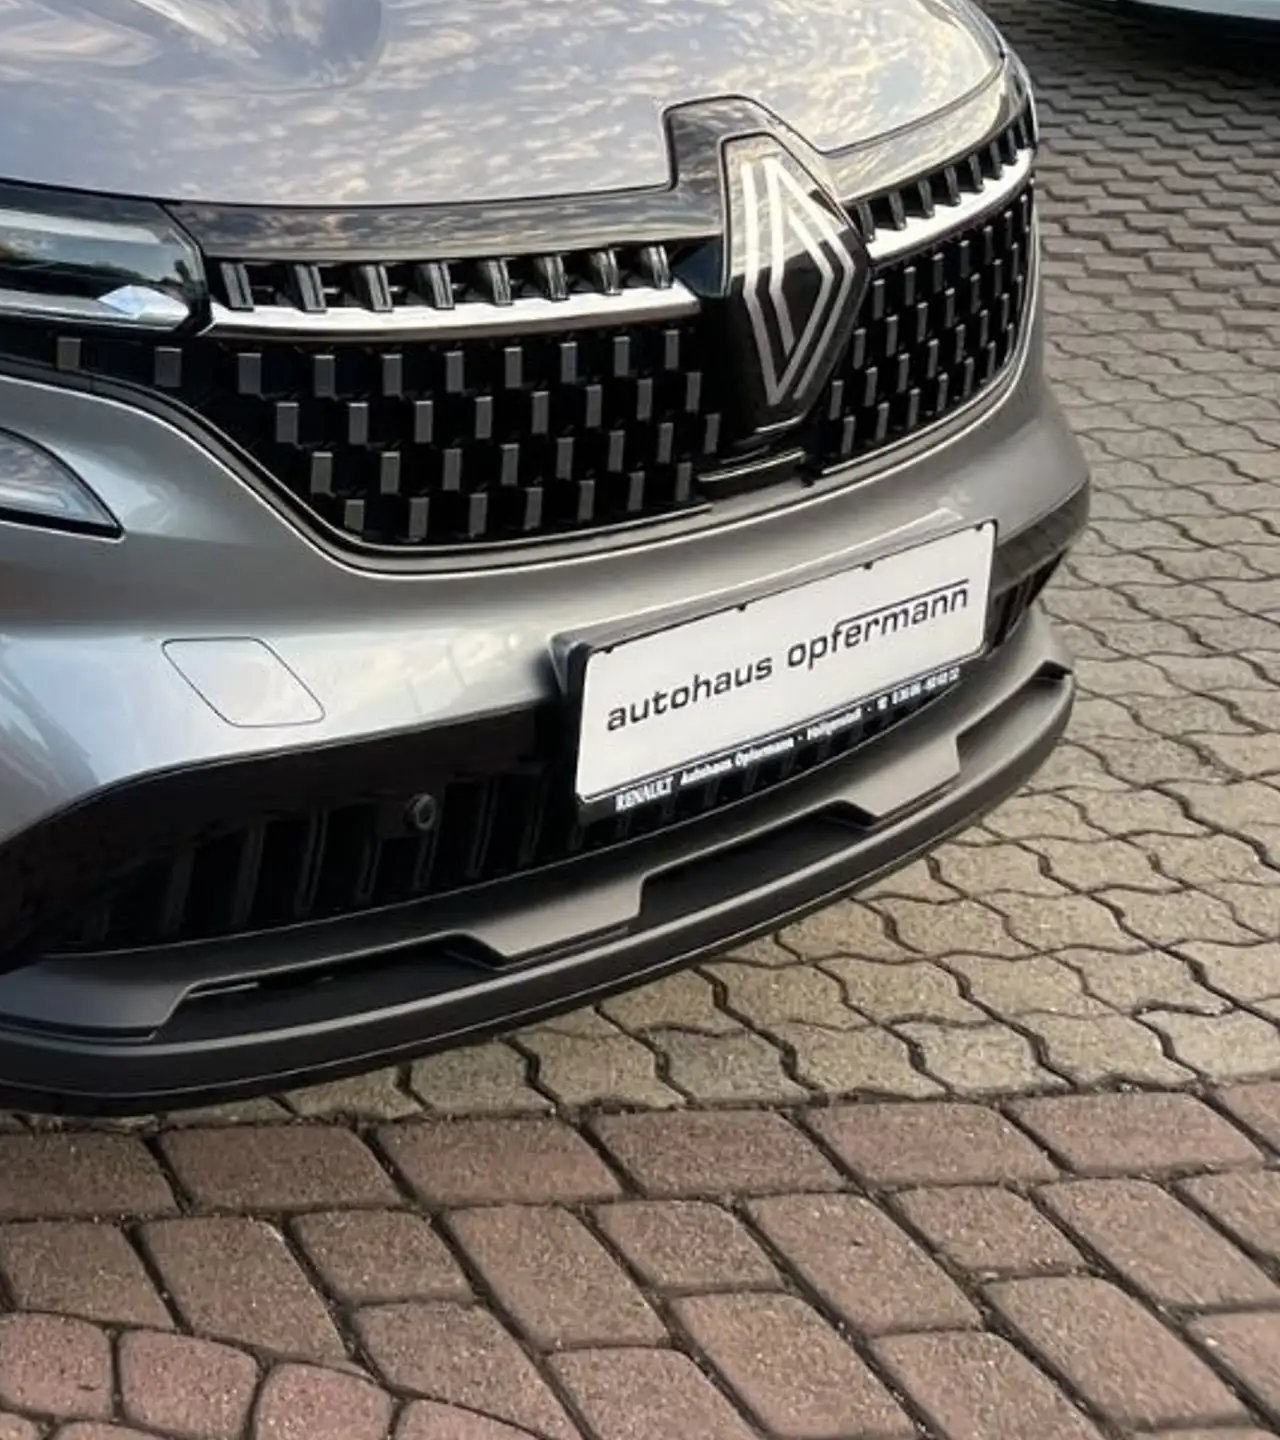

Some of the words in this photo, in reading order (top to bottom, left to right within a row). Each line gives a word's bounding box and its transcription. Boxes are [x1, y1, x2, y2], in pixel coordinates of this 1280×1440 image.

[606, 657, 773, 732] autohaus
[786, 579, 969, 672] opfermann
[615, 775, 674, 813] RENAULT
